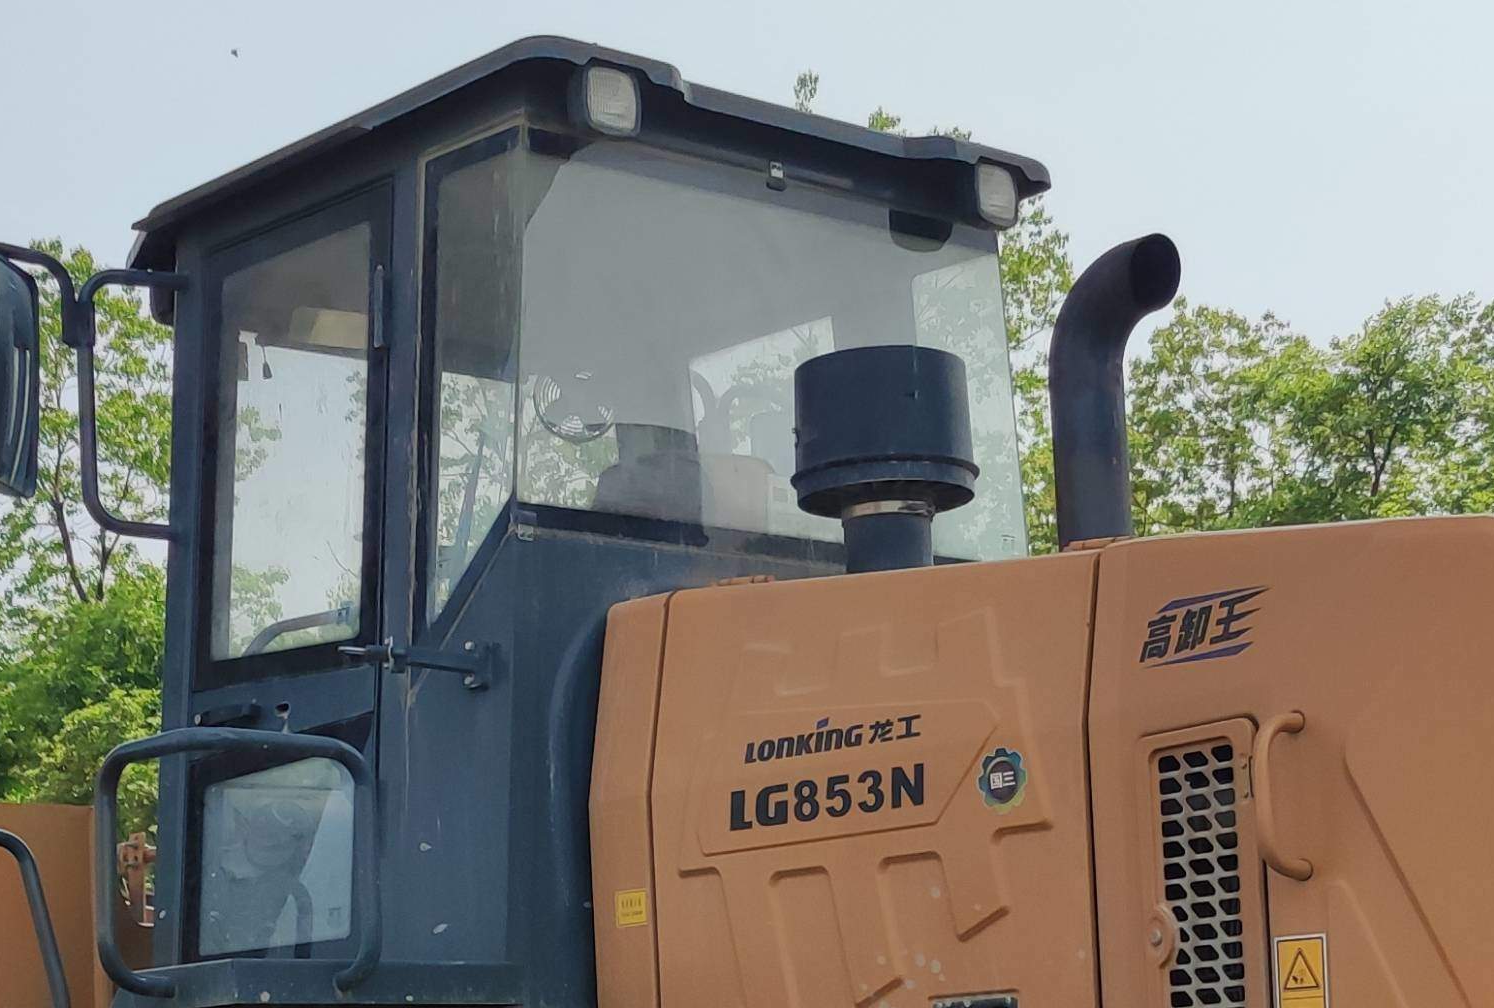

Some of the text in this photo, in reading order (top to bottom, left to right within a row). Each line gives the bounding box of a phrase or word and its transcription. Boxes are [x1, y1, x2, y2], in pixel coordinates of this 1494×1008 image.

[1139, 587, 1270, 663] 高卸王
[868, 714, 922, 745] 龙工
[730, 763, 925, 831] LG853N
[989, 770, 1016, 790] 国三
